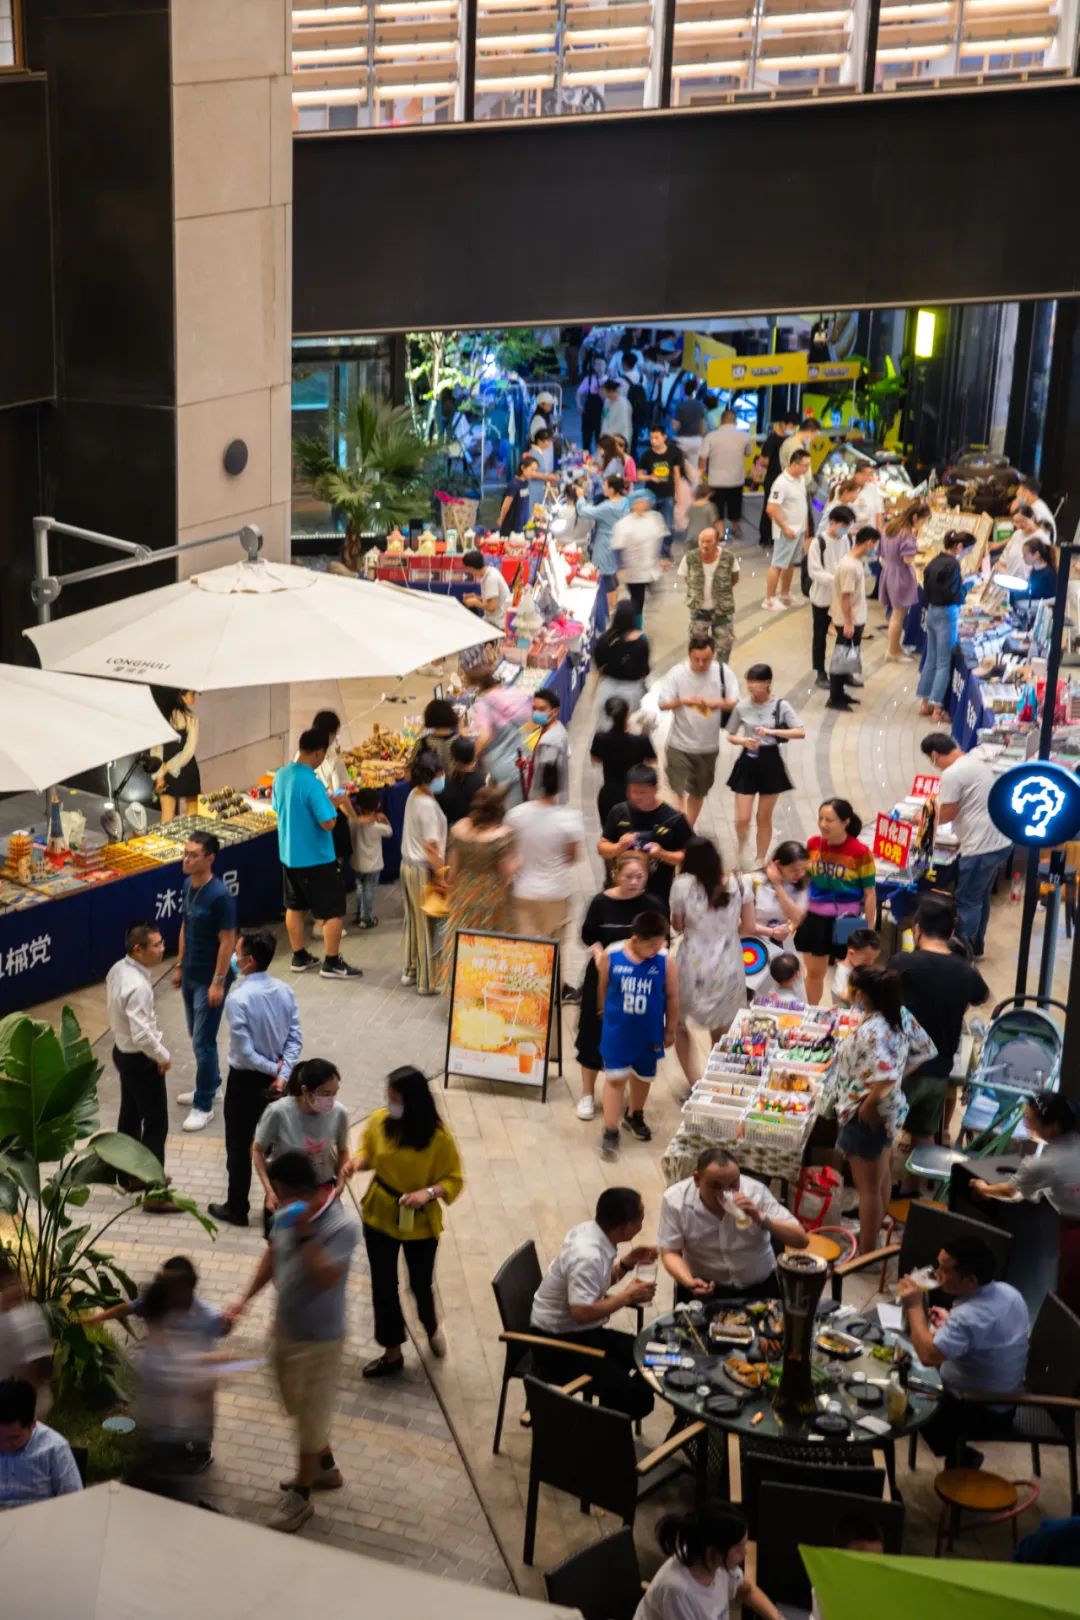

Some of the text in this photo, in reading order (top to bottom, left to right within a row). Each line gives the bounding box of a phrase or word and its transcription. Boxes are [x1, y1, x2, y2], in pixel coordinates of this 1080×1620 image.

[105, 656, 172, 670] LONGHULI
[0, 934, 51, 978] 械党
[622, 992, 648, 1015] 20
